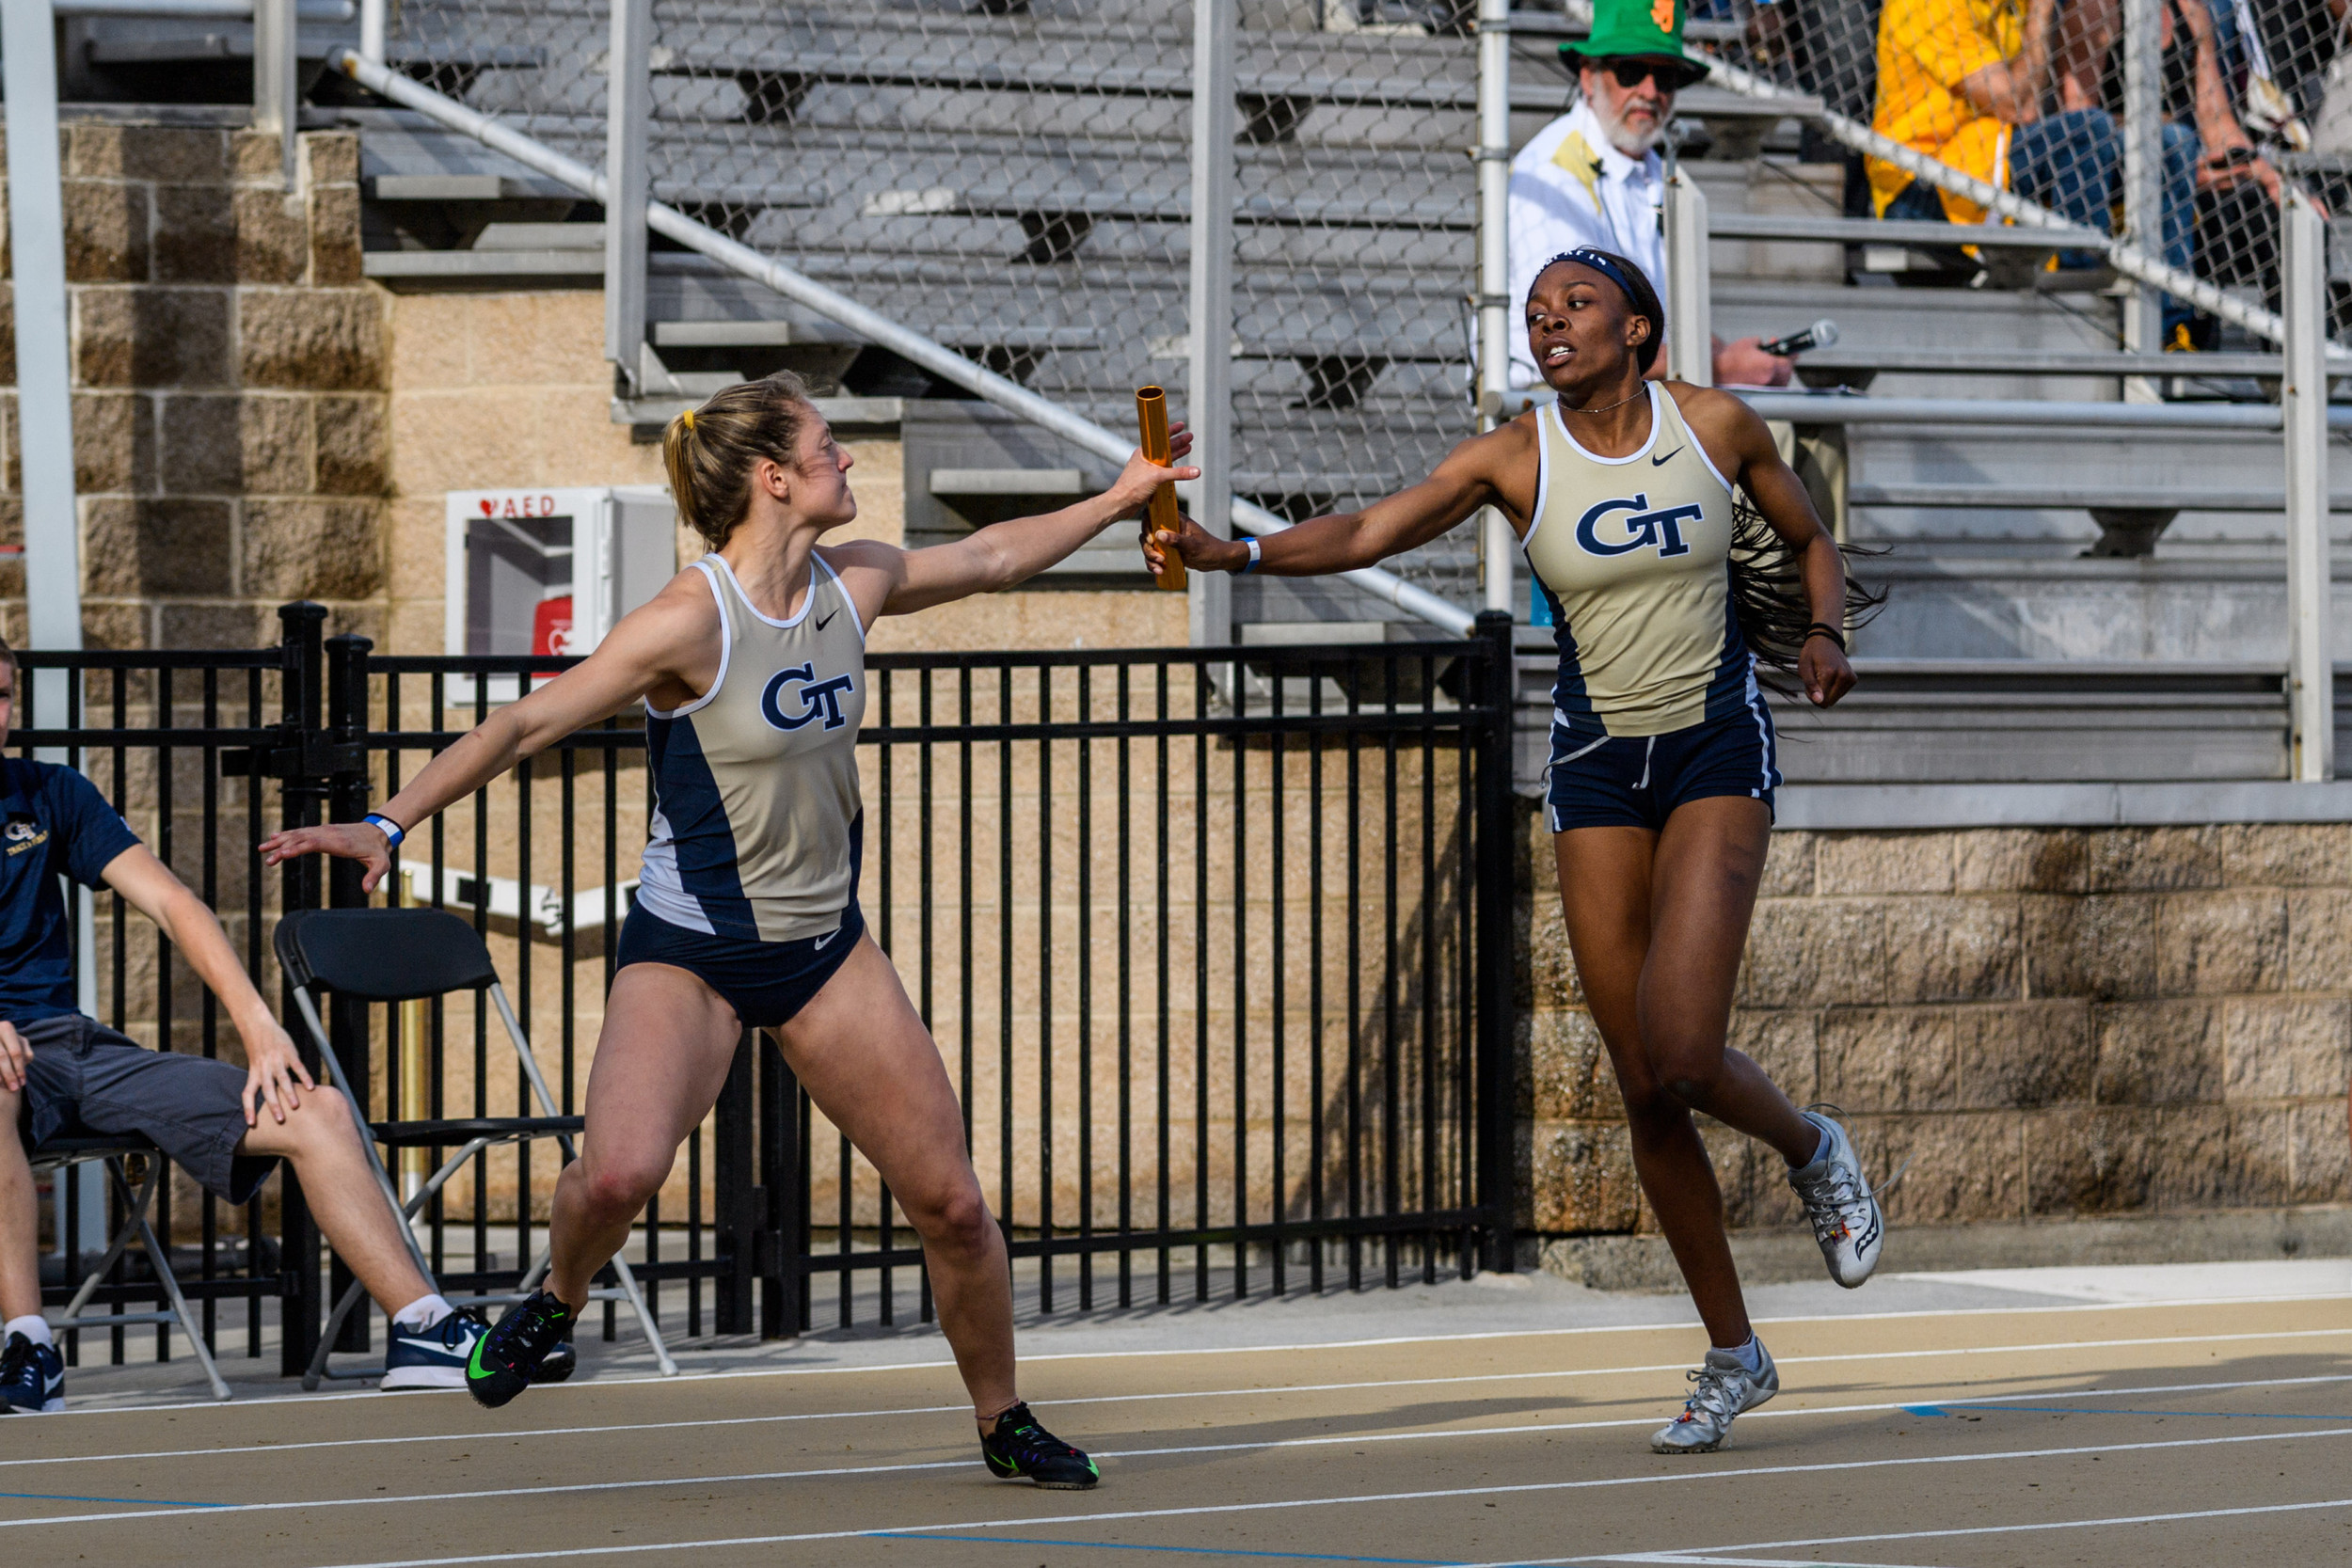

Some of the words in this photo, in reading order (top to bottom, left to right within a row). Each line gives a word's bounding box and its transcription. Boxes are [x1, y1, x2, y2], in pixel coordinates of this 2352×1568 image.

[502, 495, 555, 518] AED
[1575, 492, 1704, 558] GT
[759, 661, 854, 732] GT
